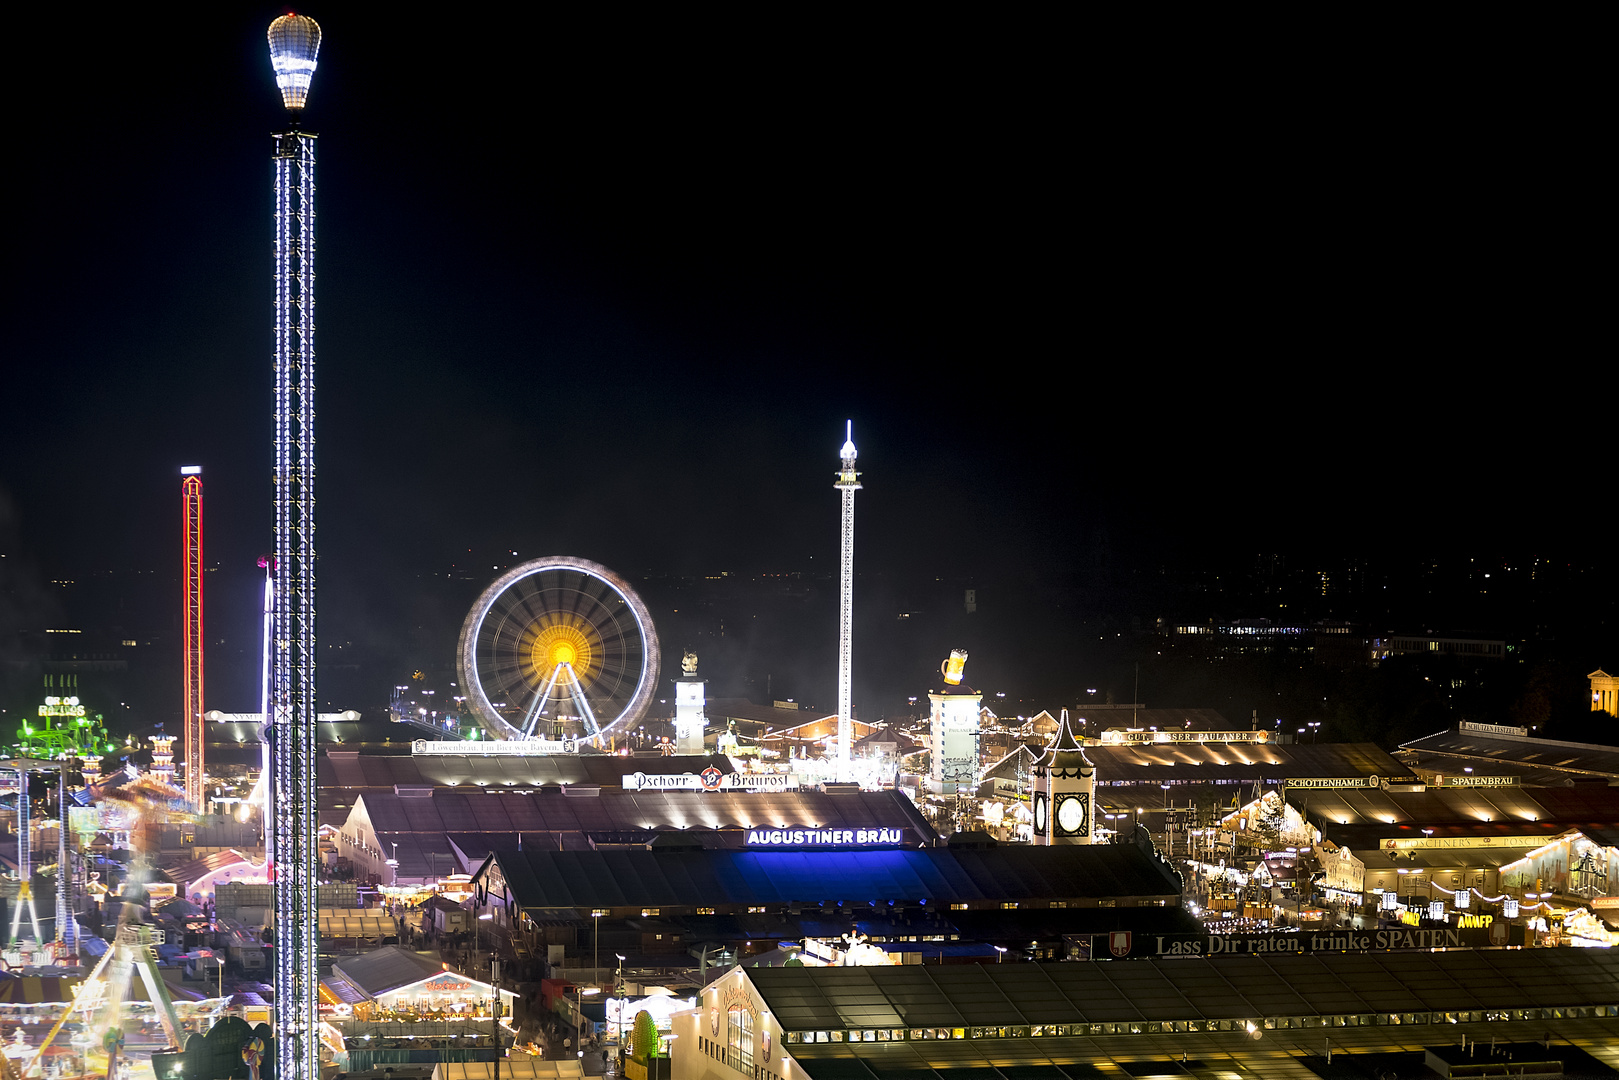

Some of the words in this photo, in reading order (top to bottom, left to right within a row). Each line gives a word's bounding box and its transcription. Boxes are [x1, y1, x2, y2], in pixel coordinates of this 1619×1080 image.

[1198, 733, 1251, 741] PAULANER.
[481, 743, 494, 751] Ein
[497, 743, 512, 751] Bier
[514, 743, 528, 751] wie
[530, 743, 560, 752] Bayern.
[1287, 779, 1366, 787] SCHOTTENHAMEL
[1452, 777, 1513, 786] SPATENBRÄU
[748, 829, 853, 844] AUGUSTINER
[856, 828, 901, 843] BRÄU
[1404, 838, 1471, 848] POSCHNER'S
[1503, 837, 1549, 846] POSCHN
[1155, 936, 1202, 955] Lass
[1207, 935, 1242, 953] Dir
[1247, 936, 1305, 952] raten,
[1311, 932, 1370, 951] trinke
[1375, 928, 1466, 950] SPATEN.
